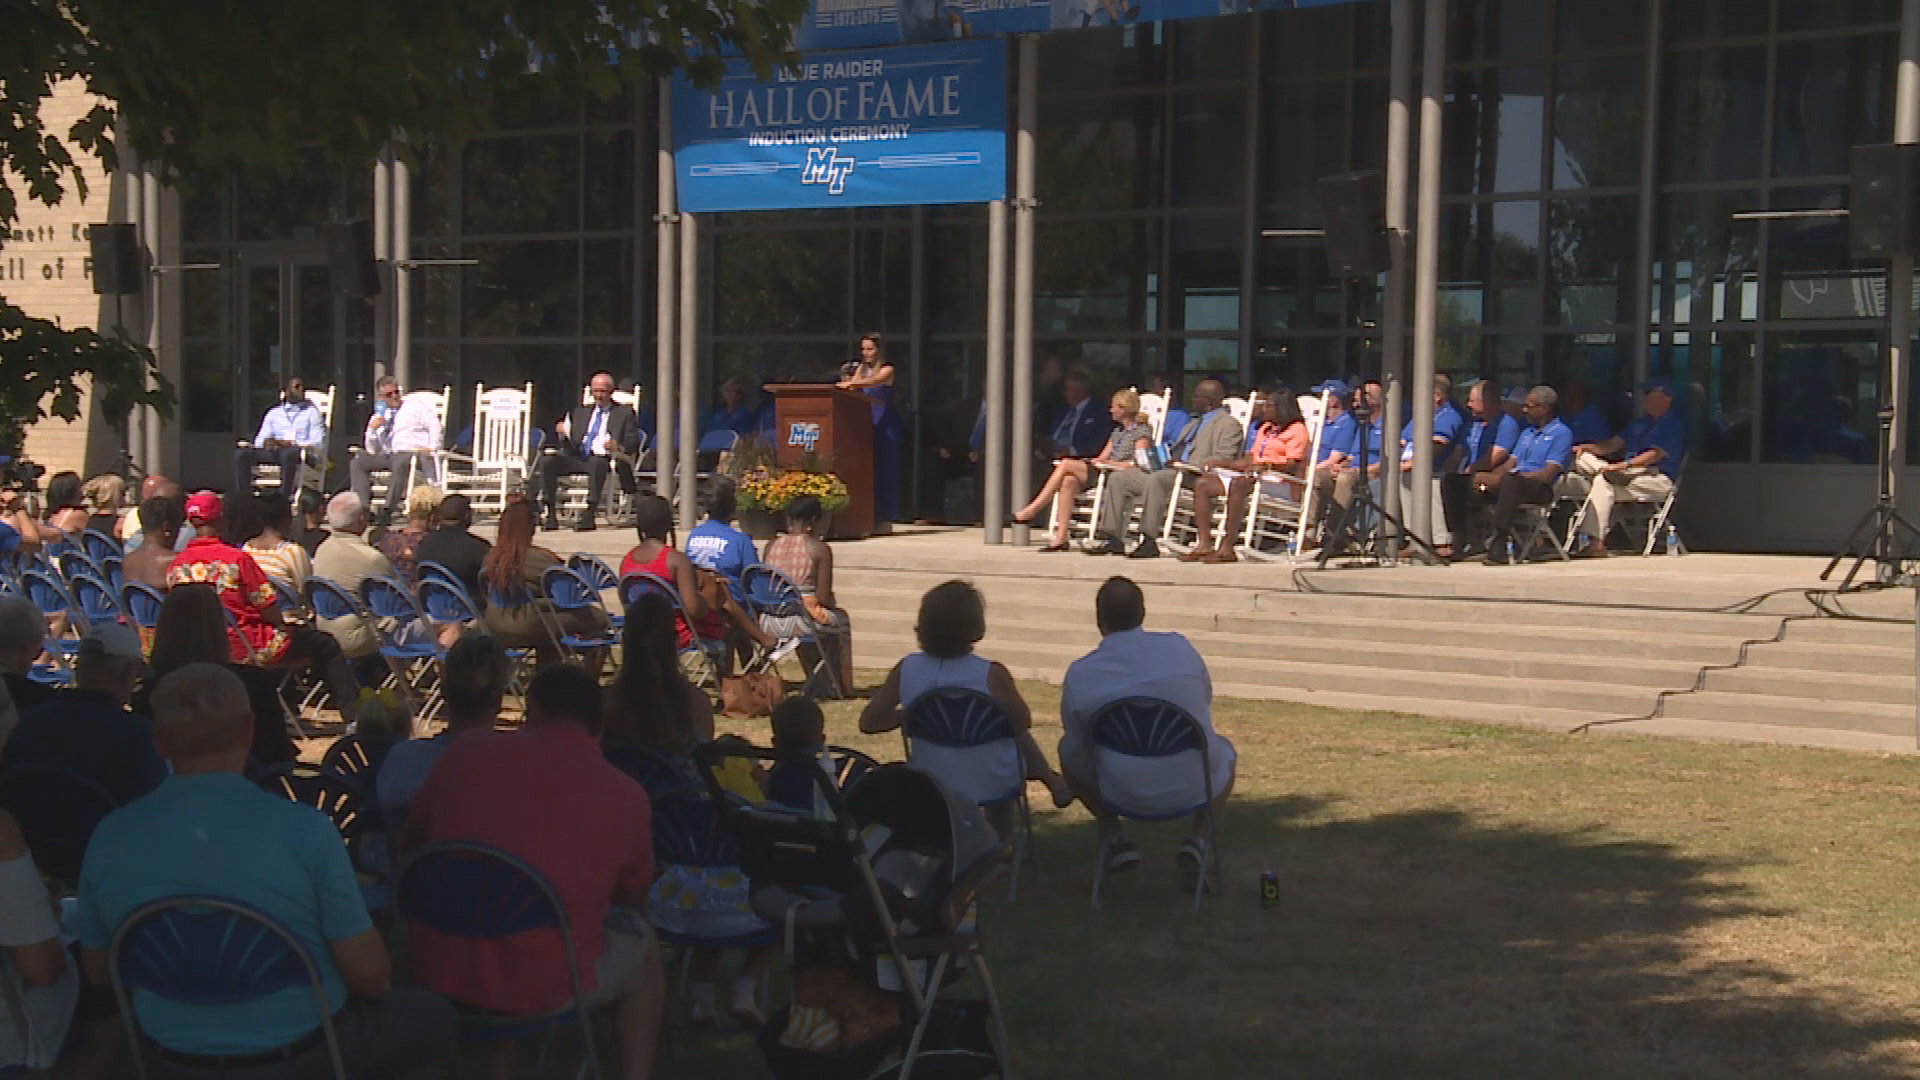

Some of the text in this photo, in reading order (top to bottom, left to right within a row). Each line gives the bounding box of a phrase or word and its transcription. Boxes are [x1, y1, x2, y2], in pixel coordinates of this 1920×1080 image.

[823, 59, 883, 80] RAIDER
[709, 74, 960, 129] HALL OF FAME
[748, 123, 910, 147] INDUCTION CEREMONY
[801, 146, 855, 196] MT
[42, 256, 64, 280] of
